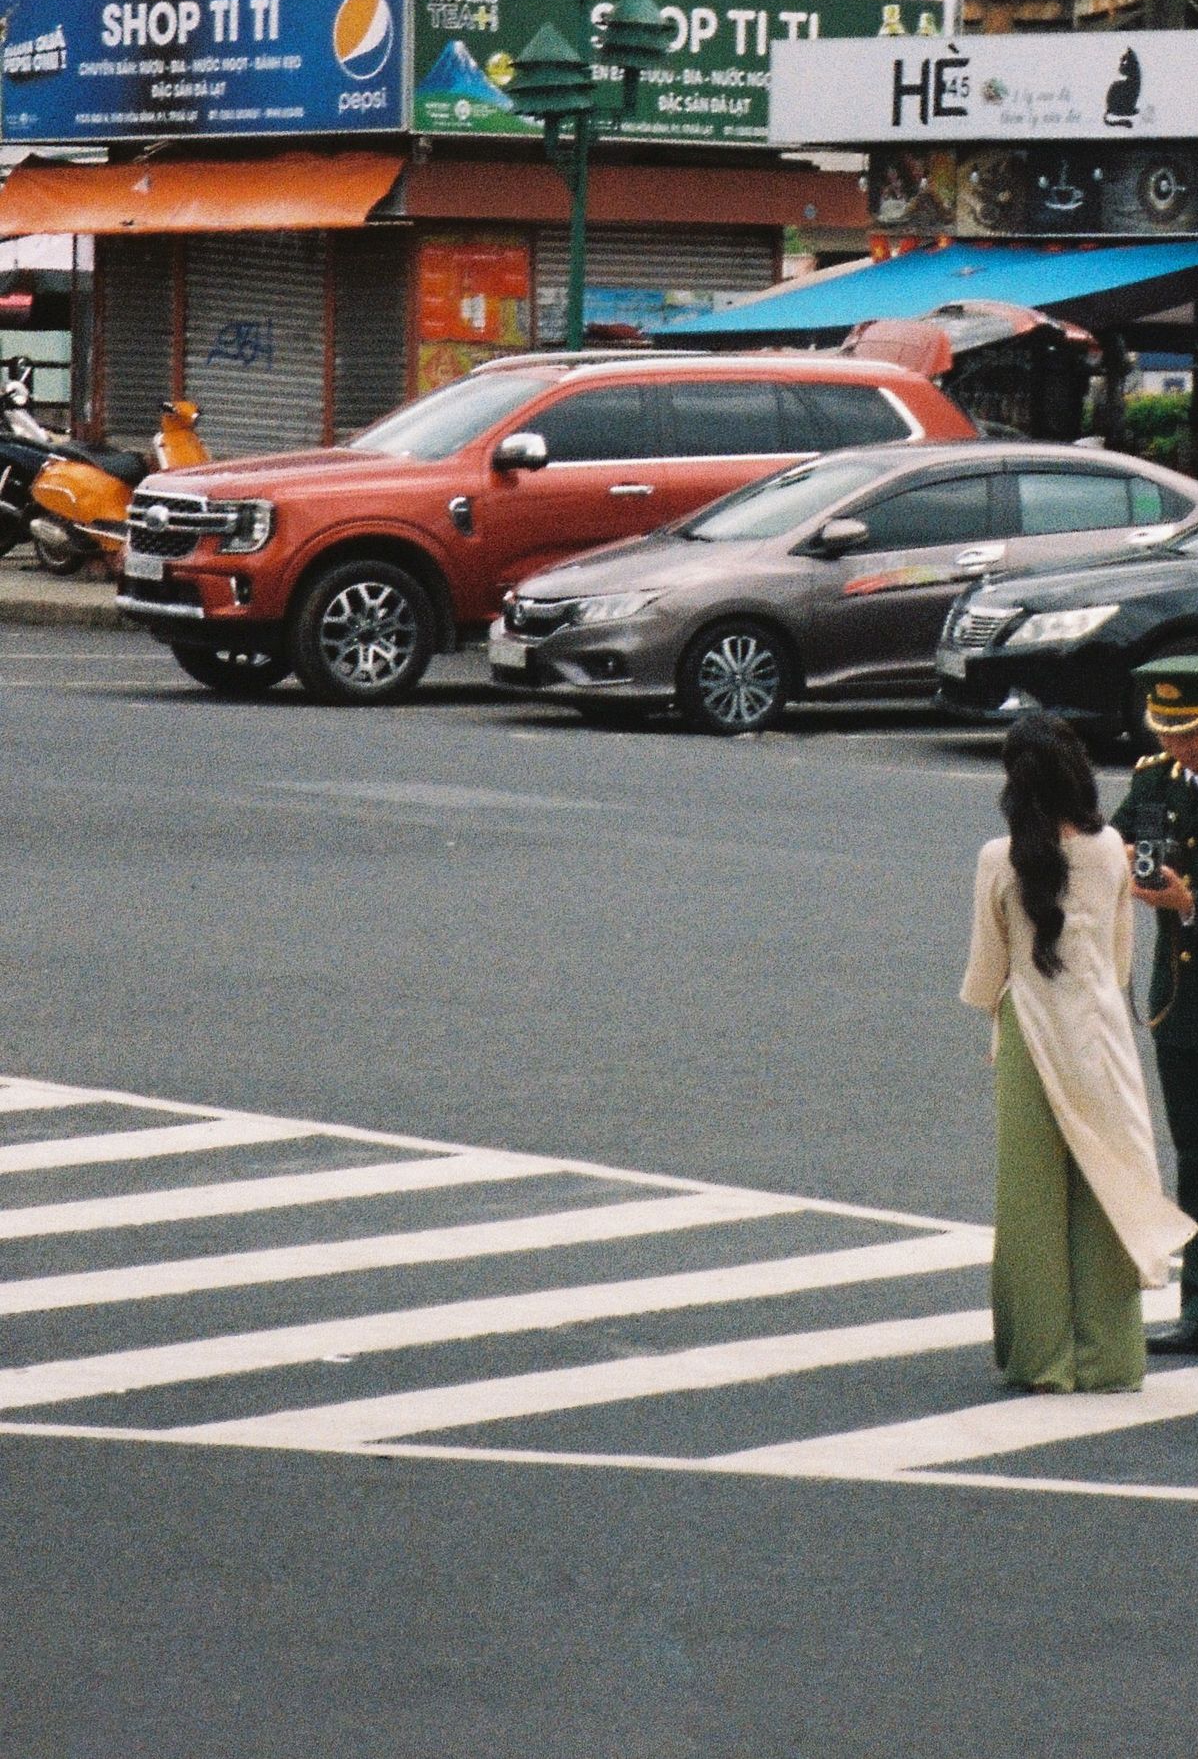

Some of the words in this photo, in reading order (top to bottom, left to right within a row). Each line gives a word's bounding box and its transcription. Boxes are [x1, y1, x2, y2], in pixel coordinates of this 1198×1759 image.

[102, 1, 200, 46] SHOP
[210, 0, 239, 42] TI
[591, 2, 718, 53] SOP
[727, 9, 767, 55] TI
[683, 69, 703, 85] BIA
[892, 43, 970, 127] HÈ
[338, 87, 387, 114] pepsi
[729, 97, 752, 117] LẠT
